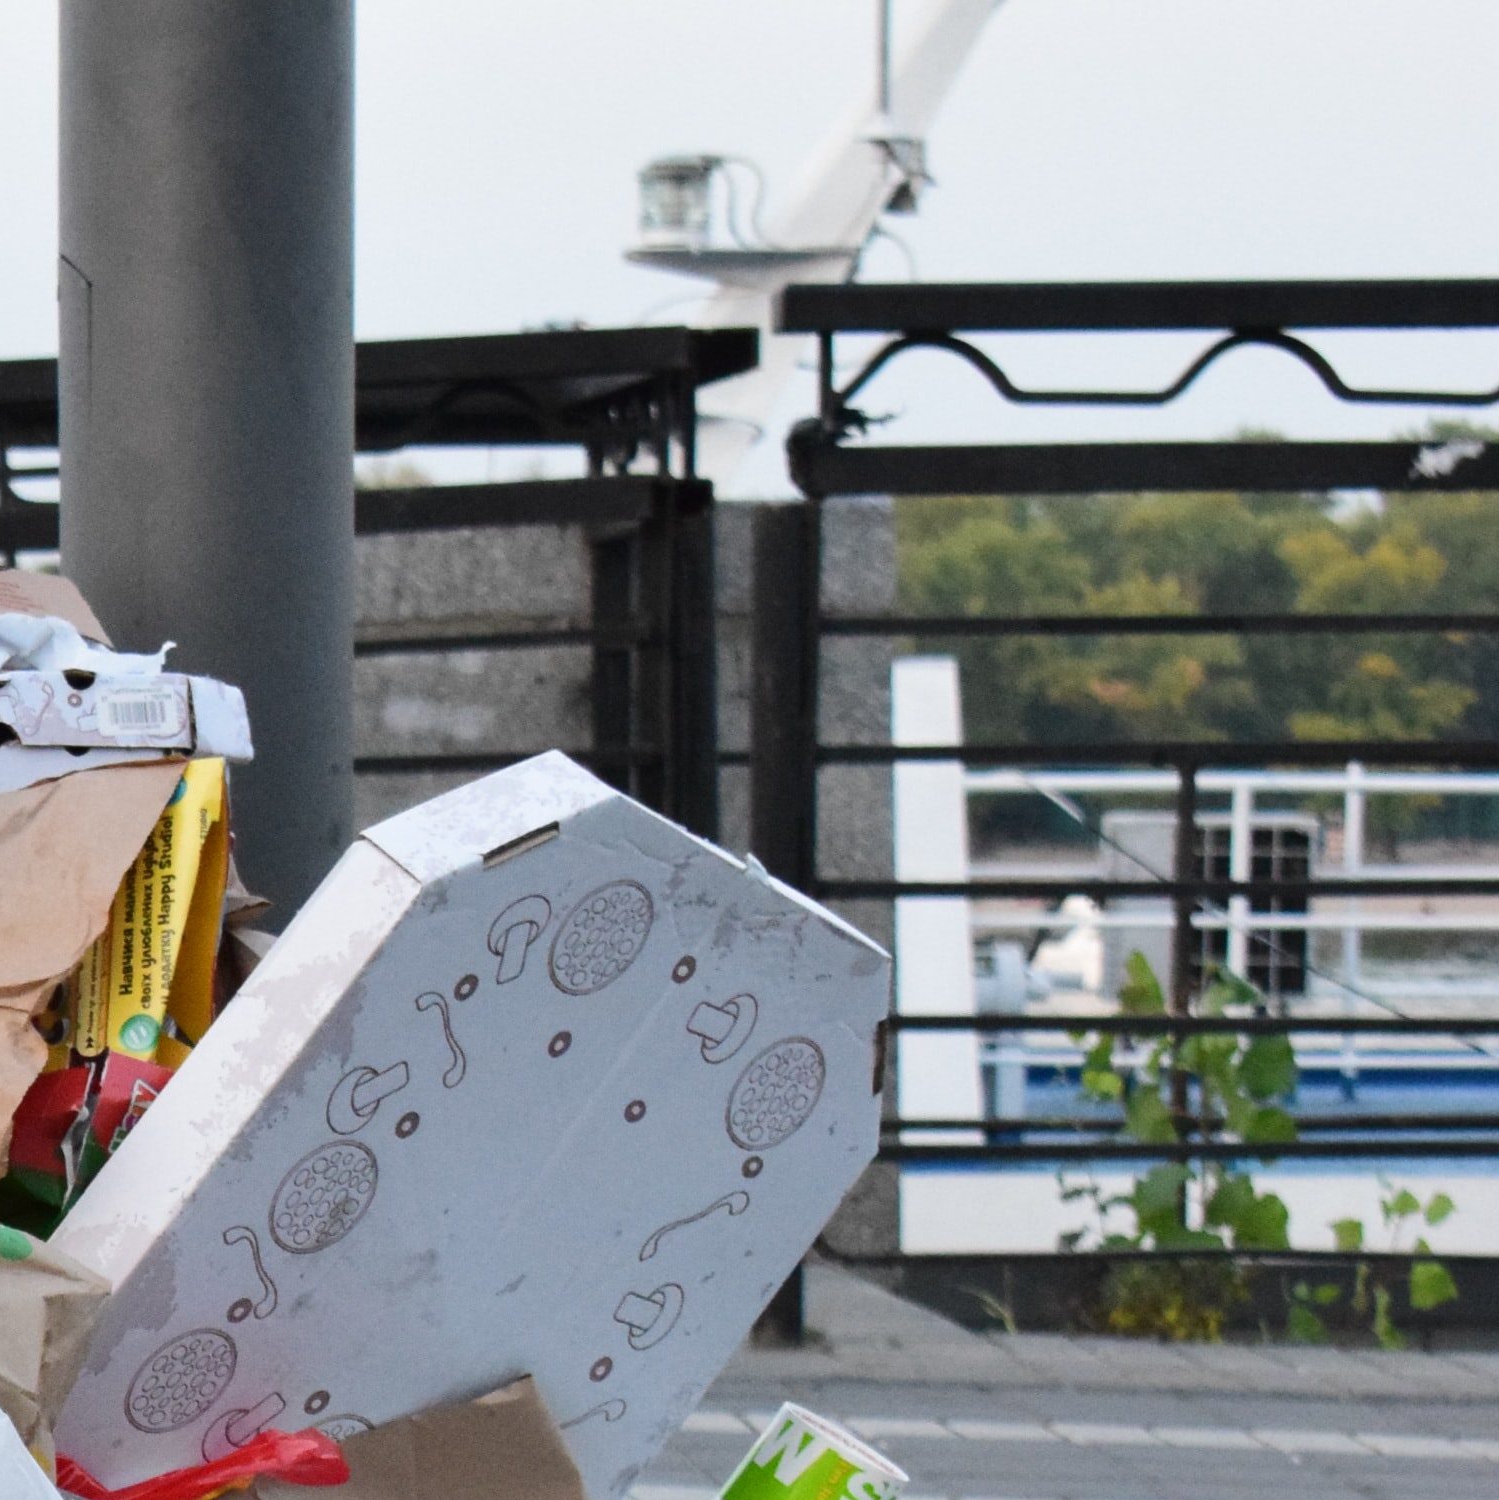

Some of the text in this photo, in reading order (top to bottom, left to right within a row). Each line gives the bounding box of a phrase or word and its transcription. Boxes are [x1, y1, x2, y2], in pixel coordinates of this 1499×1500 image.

[158, 815, 173, 870] Studio!
[157, 874, 176, 926] Happy
[118, 925, 135, 997] Навчися
[140, 883, 157, 1010] своїх улюблених
